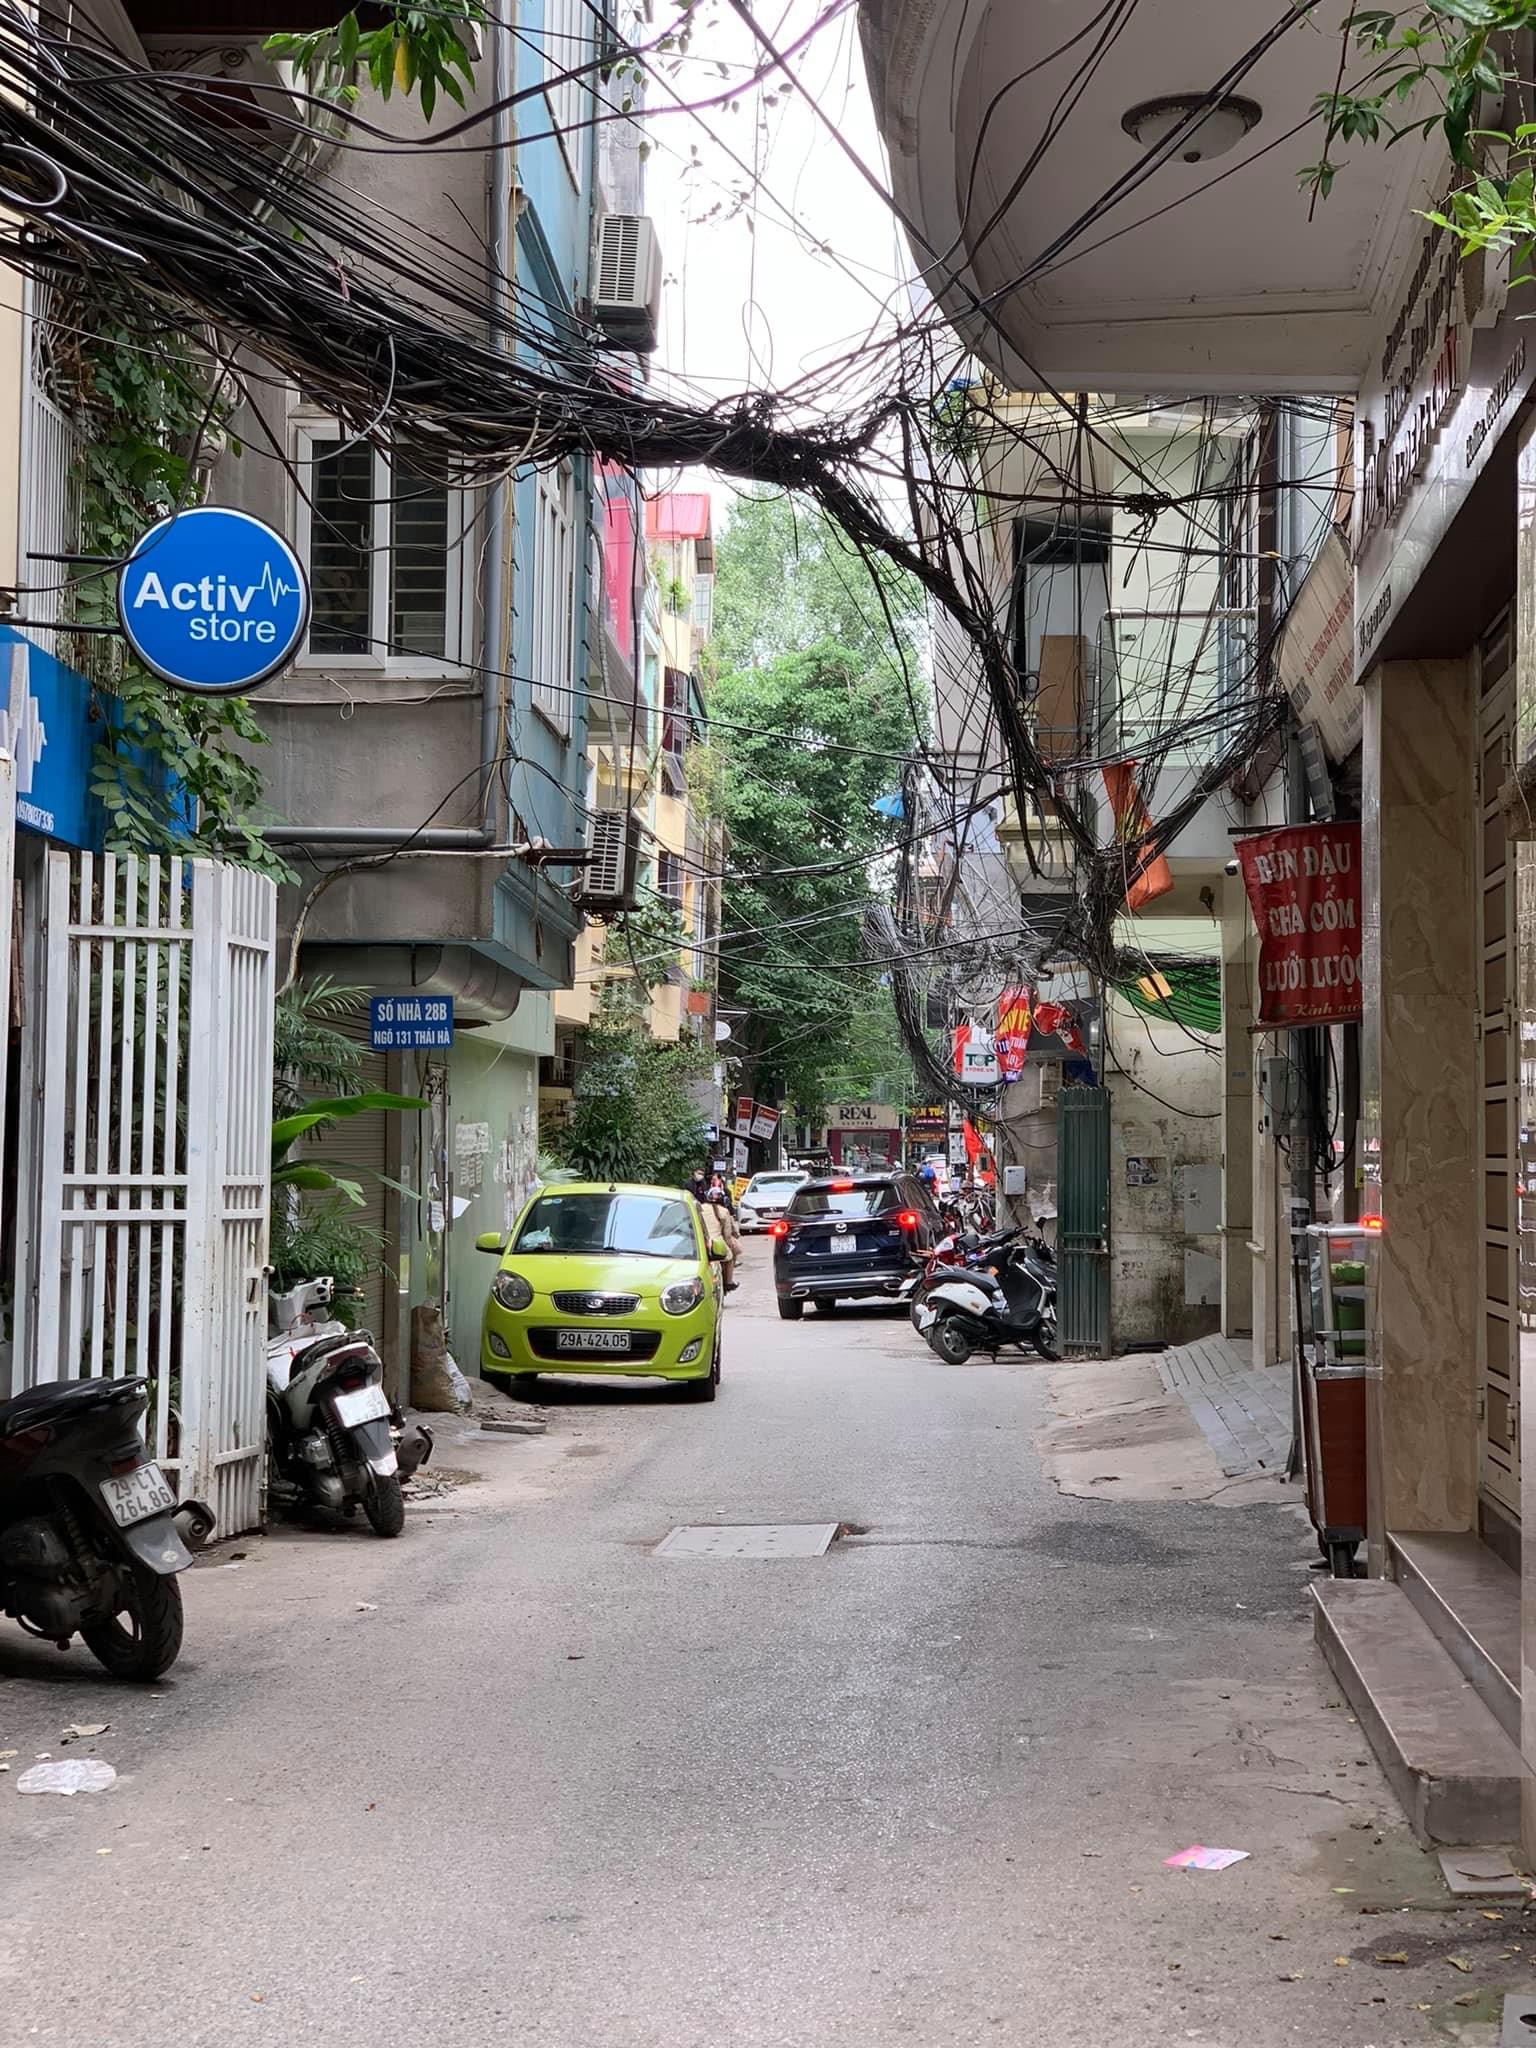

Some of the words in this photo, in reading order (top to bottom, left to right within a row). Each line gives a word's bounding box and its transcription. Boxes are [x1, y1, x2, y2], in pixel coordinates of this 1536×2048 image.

[133, 572, 256, 612] Activ
[189, 612, 277, 643] store
[1254, 842, 1300, 884] BÚN
[1303, 835, 1351, 883] ĐẬU
[1269, 890, 1306, 937] CHẢ
[1310, 884, 1356, 933] CỐM
[377, 998, 394, 1021] SỐ
[397, 999, 422, 1021] NHÀ
[425, 1003, 447, 1020] 28B
[1295, 1002, 1333, 1016] Kinh
[374, 1029, 393, 1044] NGÕ
[396, 1031, 411, 1044] 131
[414, 1027, 434, 1044] THÁI
[437, 1027, 450, 1044] HÀ
[965, 1053, 996, 1066] TOP
[840, 1106, 877, 1120] REAL
[115, 1486, 171, 1522] 264.86
